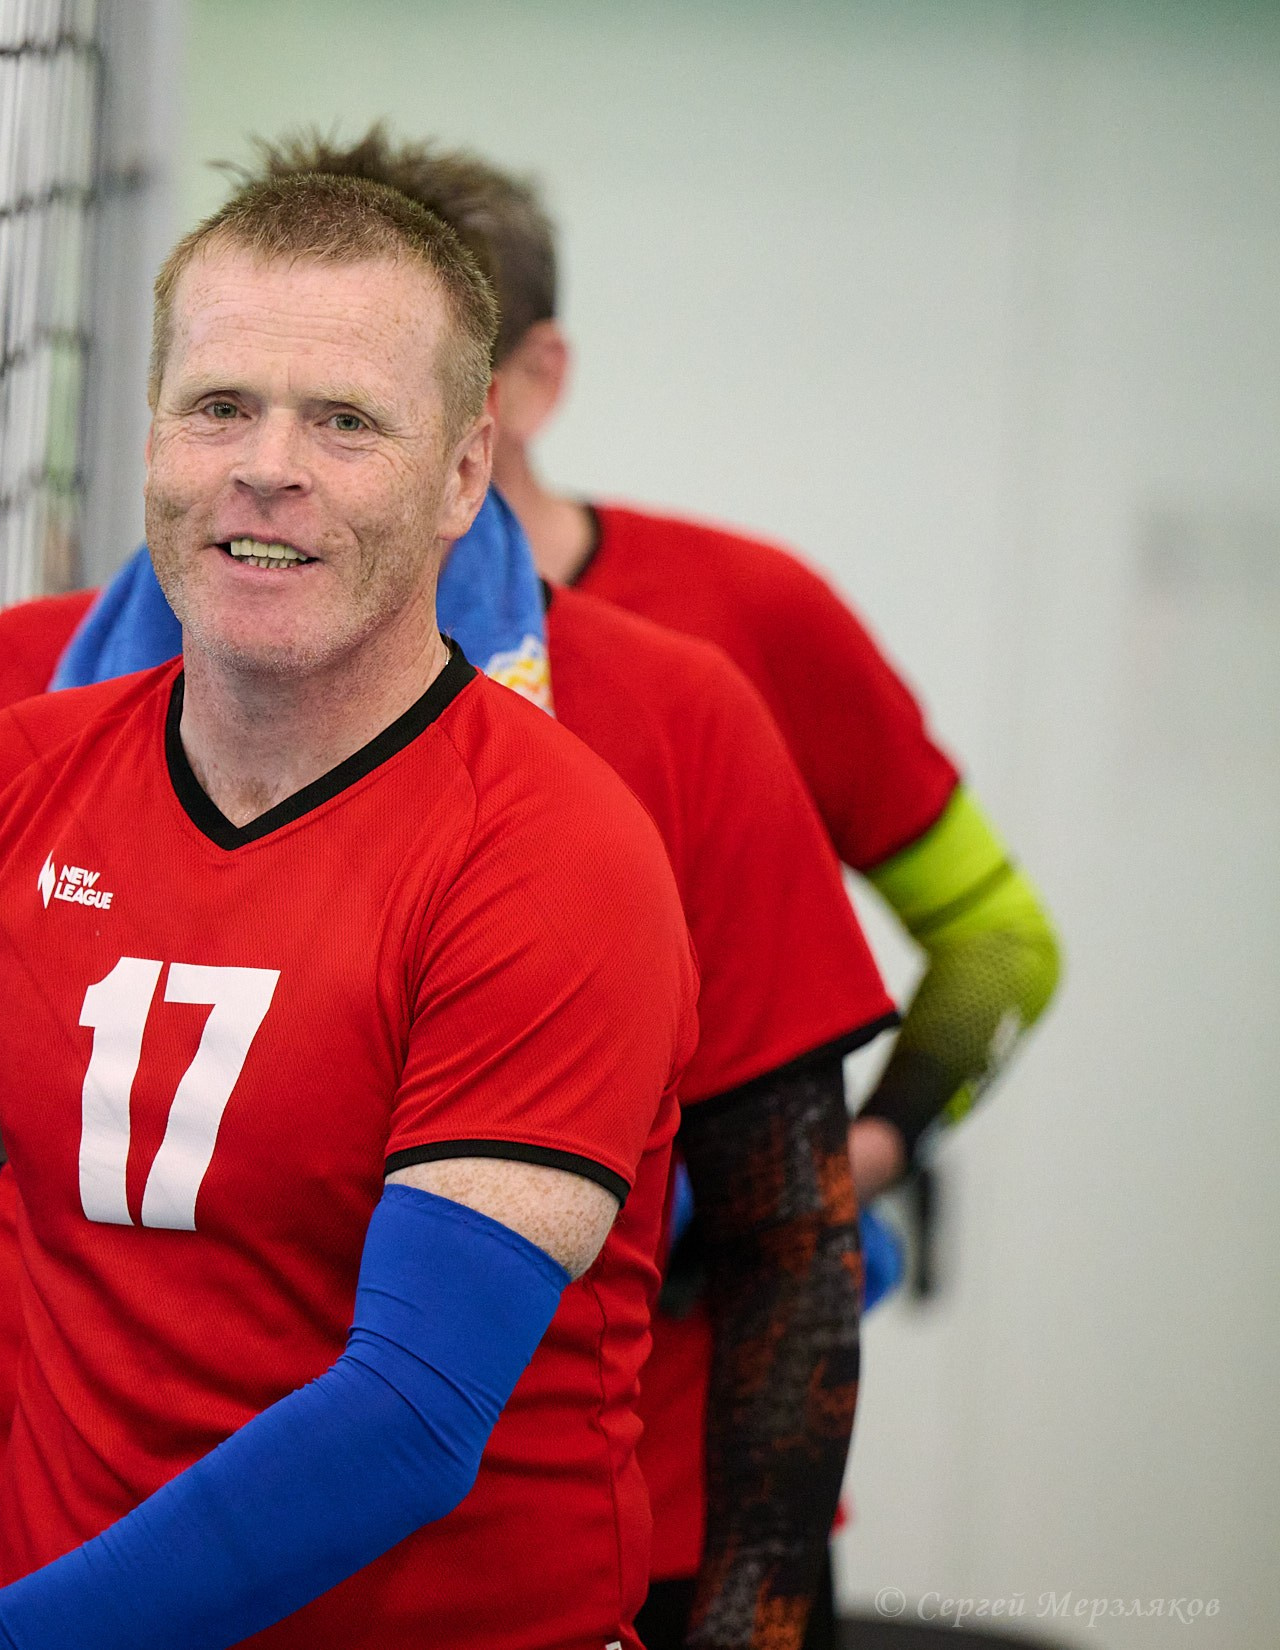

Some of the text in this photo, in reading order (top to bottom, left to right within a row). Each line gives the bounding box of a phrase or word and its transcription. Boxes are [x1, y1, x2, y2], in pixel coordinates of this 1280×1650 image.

[59, 865, 100, 887] NEW
[54, 882, 113, 910] LEAGUE
[78, 956, 281, 1231] 17
